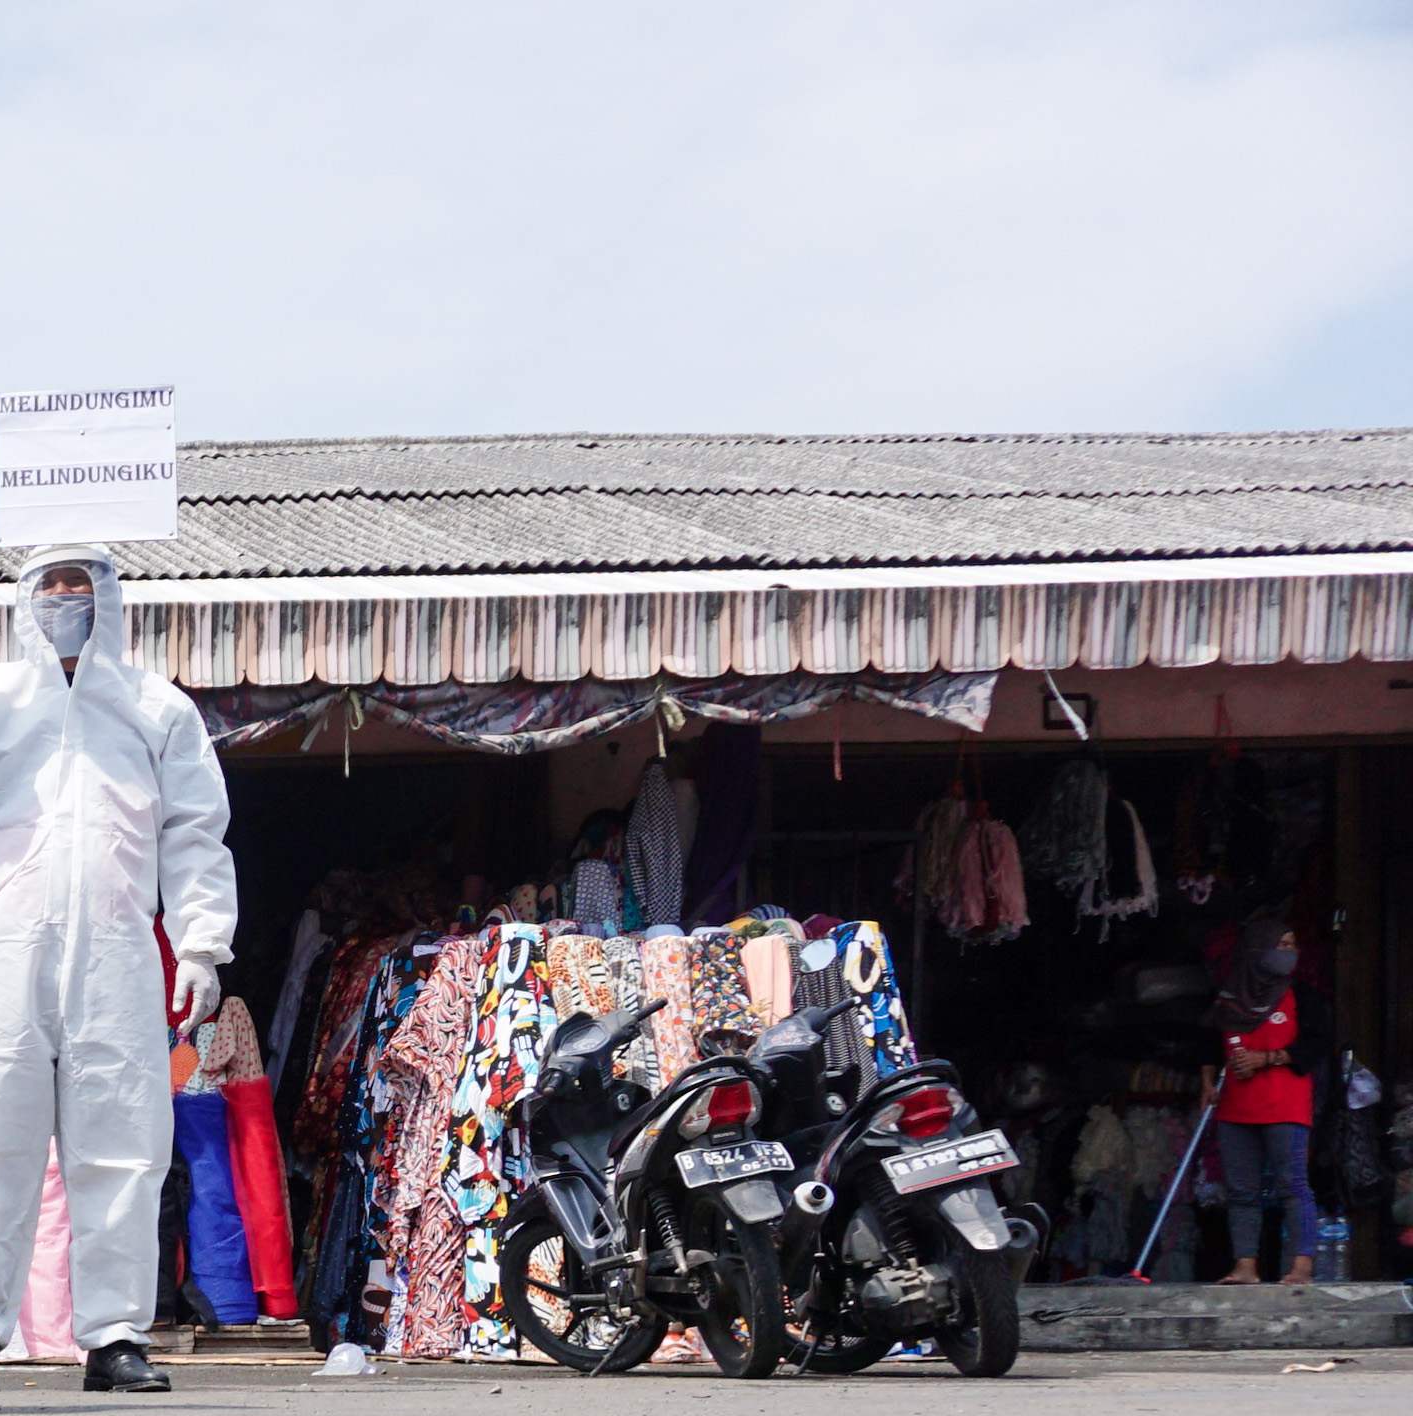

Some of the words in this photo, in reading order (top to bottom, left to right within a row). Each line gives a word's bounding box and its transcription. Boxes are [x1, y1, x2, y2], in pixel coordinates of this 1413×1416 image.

[0, 462, 174, 488] MELINDUNGIKU
[680, 1154, 695, 1170] B
[702, 1147, 745, 1166] 6524
